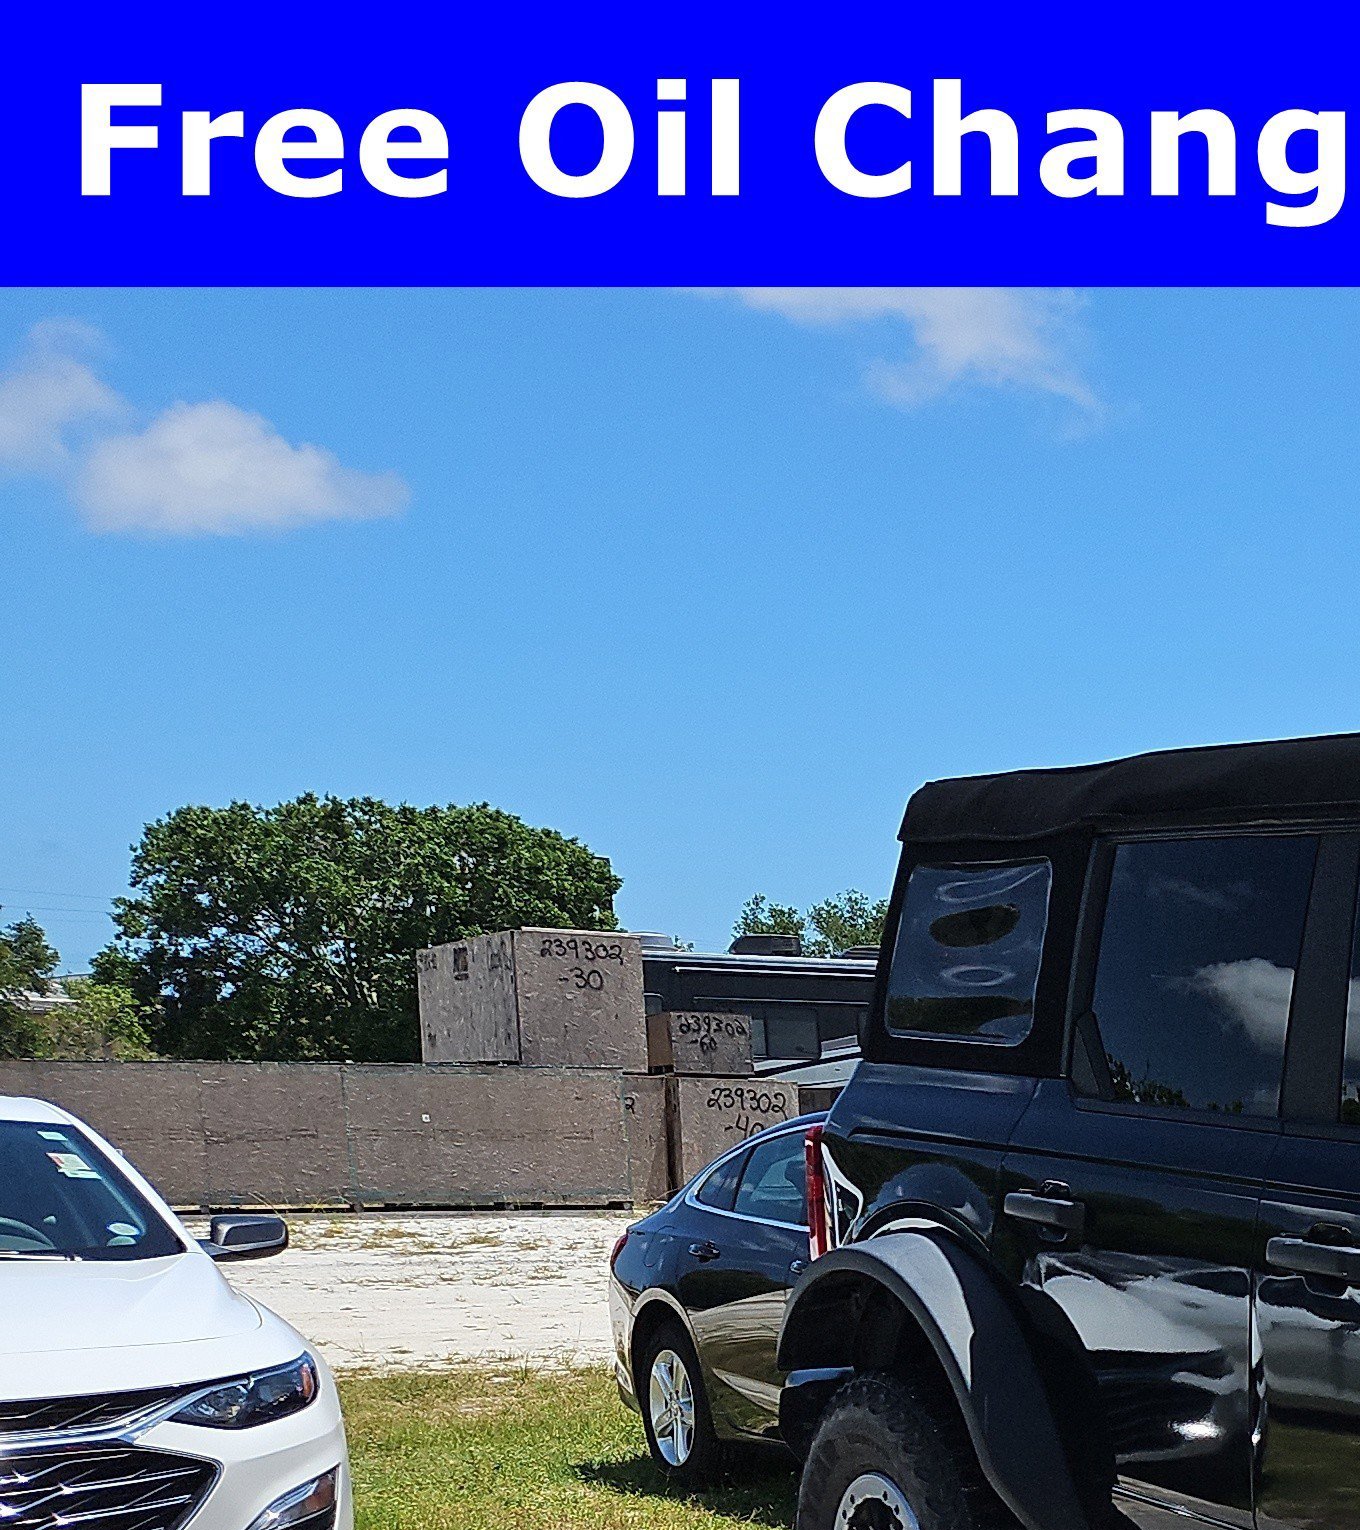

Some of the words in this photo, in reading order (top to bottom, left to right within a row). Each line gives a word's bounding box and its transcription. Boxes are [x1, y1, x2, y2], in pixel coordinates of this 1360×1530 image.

[539, 938, 624, 966] 239302
[558, 966, 605, 991] -30
[676, 1014, 748, 1036] 239302
[706, 1087, 788, 1121] 239302
